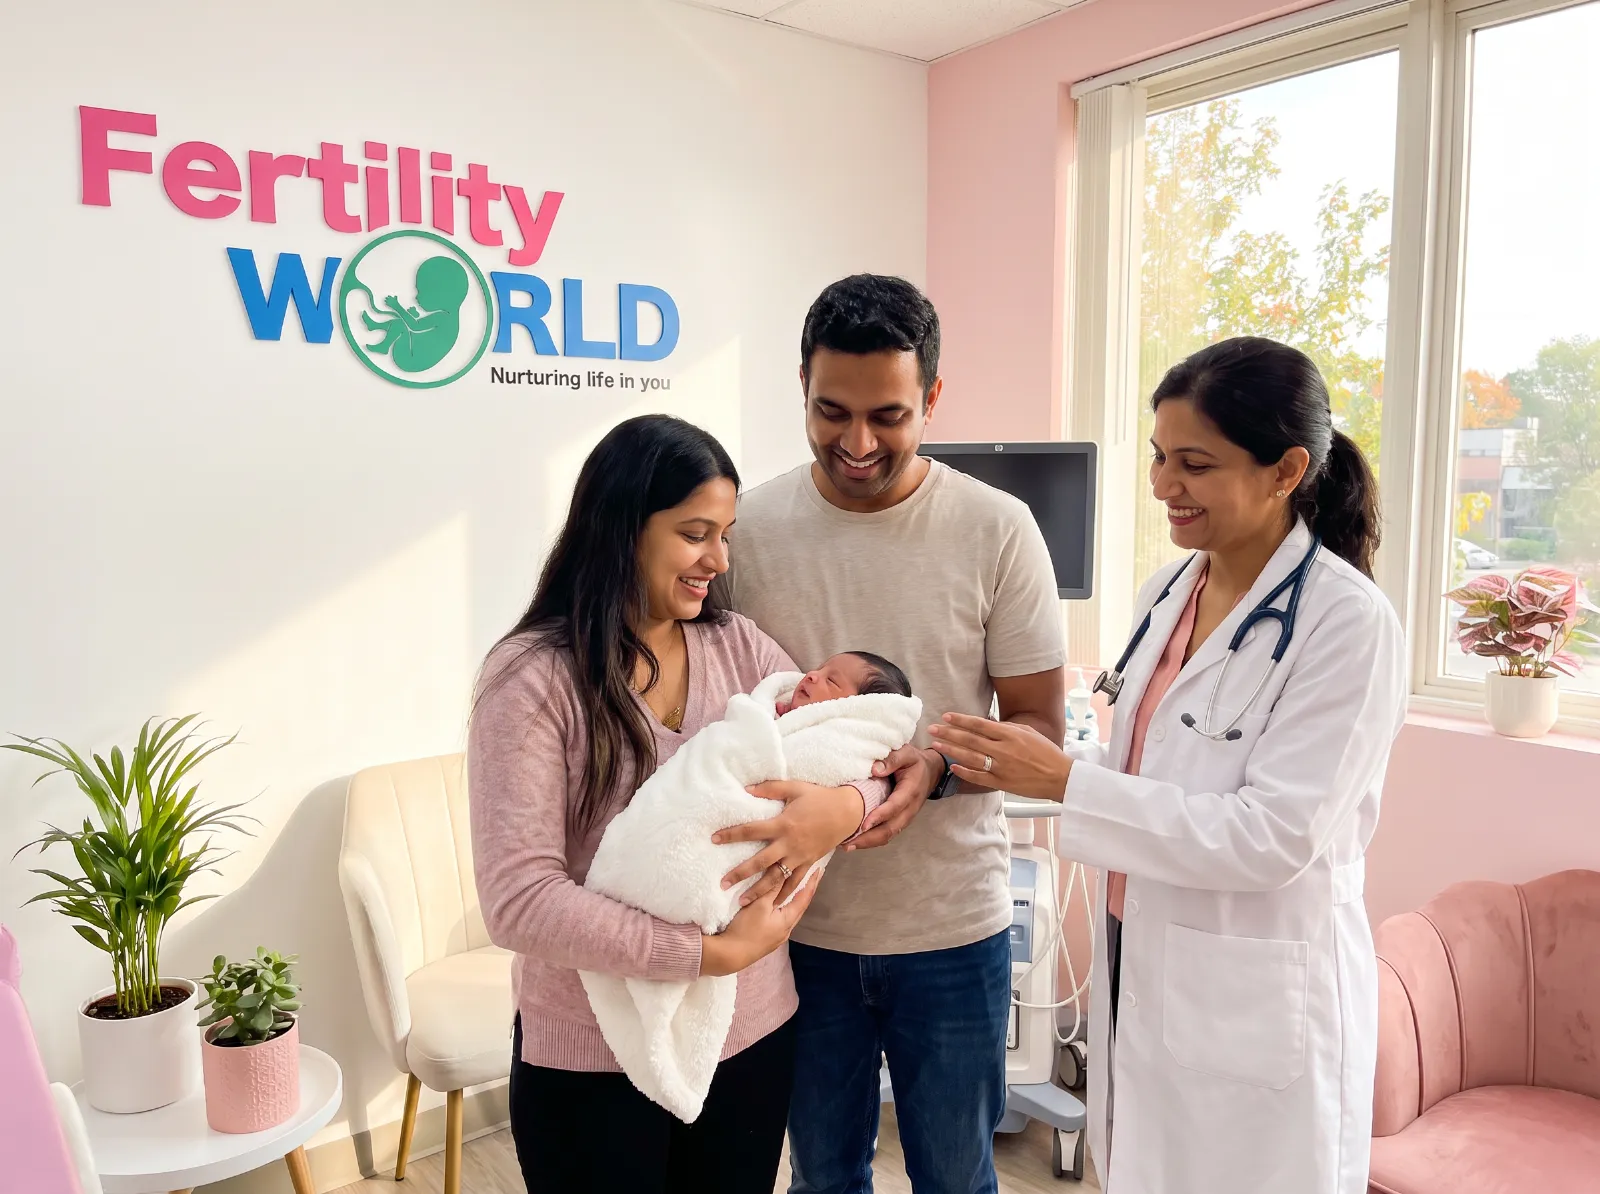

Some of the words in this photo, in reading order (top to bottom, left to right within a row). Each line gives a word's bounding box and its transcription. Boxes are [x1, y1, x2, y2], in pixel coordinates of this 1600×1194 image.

[79, 104, 565, 266] Fertility
[490, 366, 581, 390] Nurturing
[587, 371, 615, 388] life
[620, 373, 635, 389] in
[640, 376, 671, 393] you
